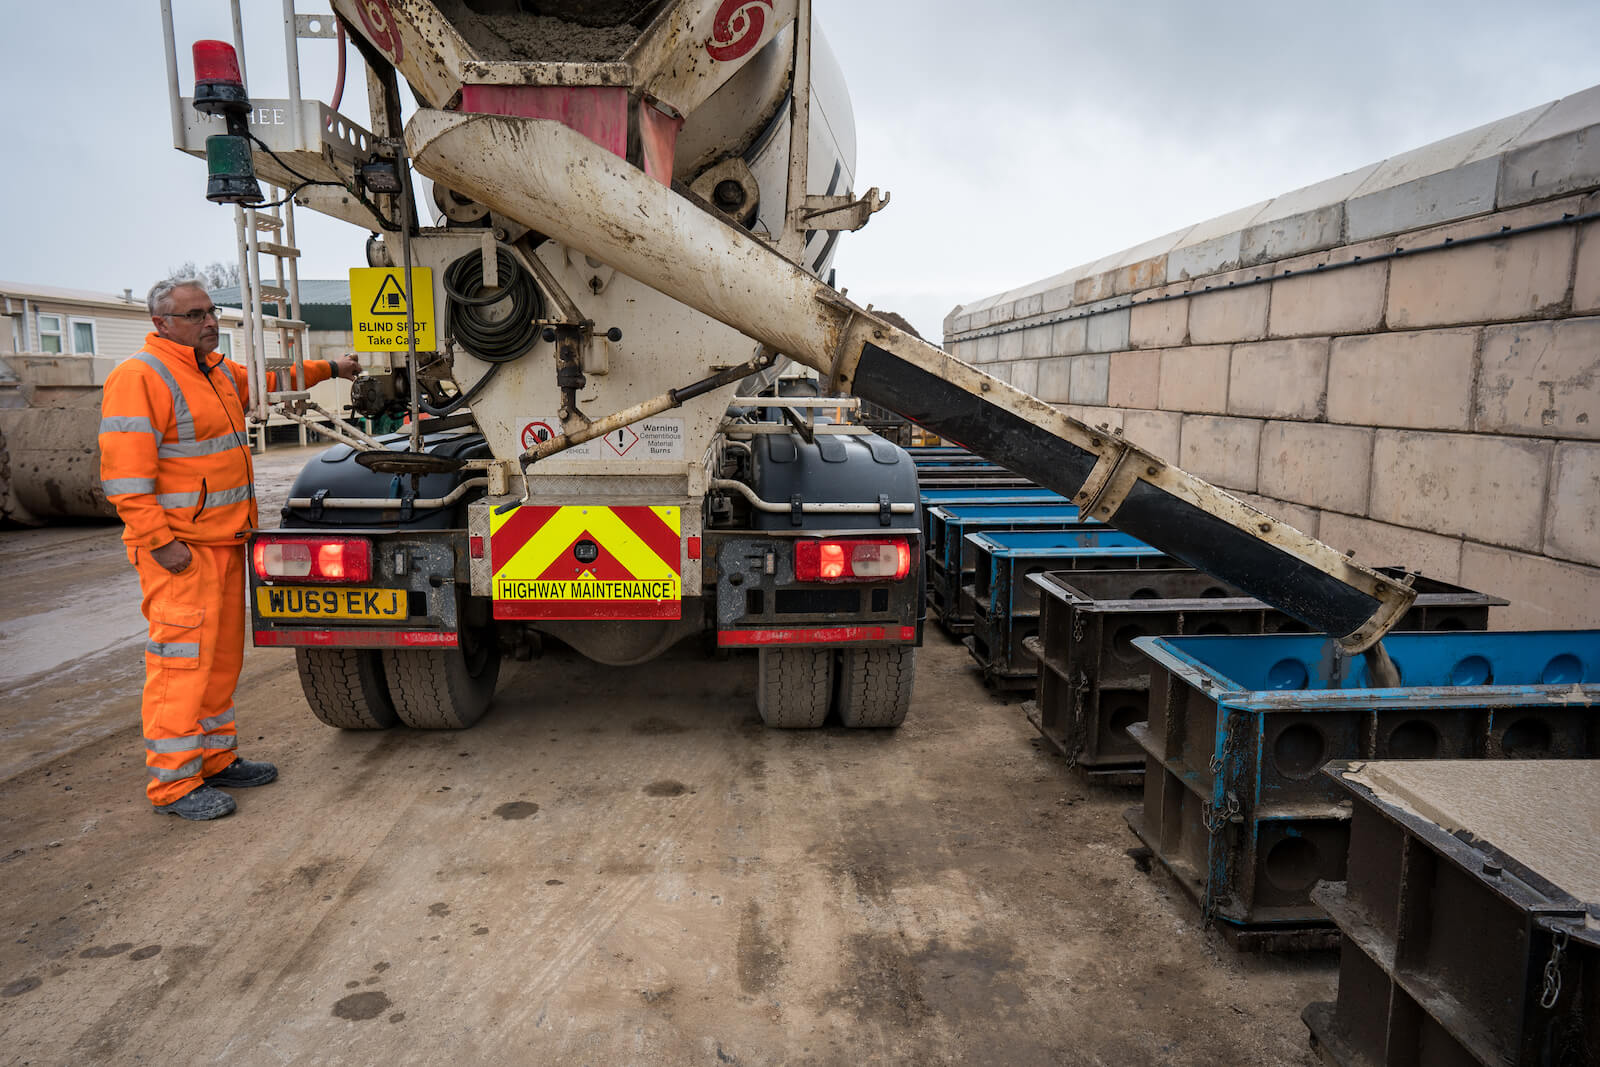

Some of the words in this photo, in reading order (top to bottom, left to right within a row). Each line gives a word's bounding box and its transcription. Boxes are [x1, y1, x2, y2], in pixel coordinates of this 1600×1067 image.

[359, 322, 393, 332] BLIND
[368, 335, 392, 345] Take
[395, 335, 420, 345] Cae
[643, 424, 679, 433] Warning
[502, 582, 567, 599] HIGHWAY
[571, 582, 671, 599] MAINTENANCE
[269, 590, 338, 614] WU69
[347, 591, 398, 616] EKJ
